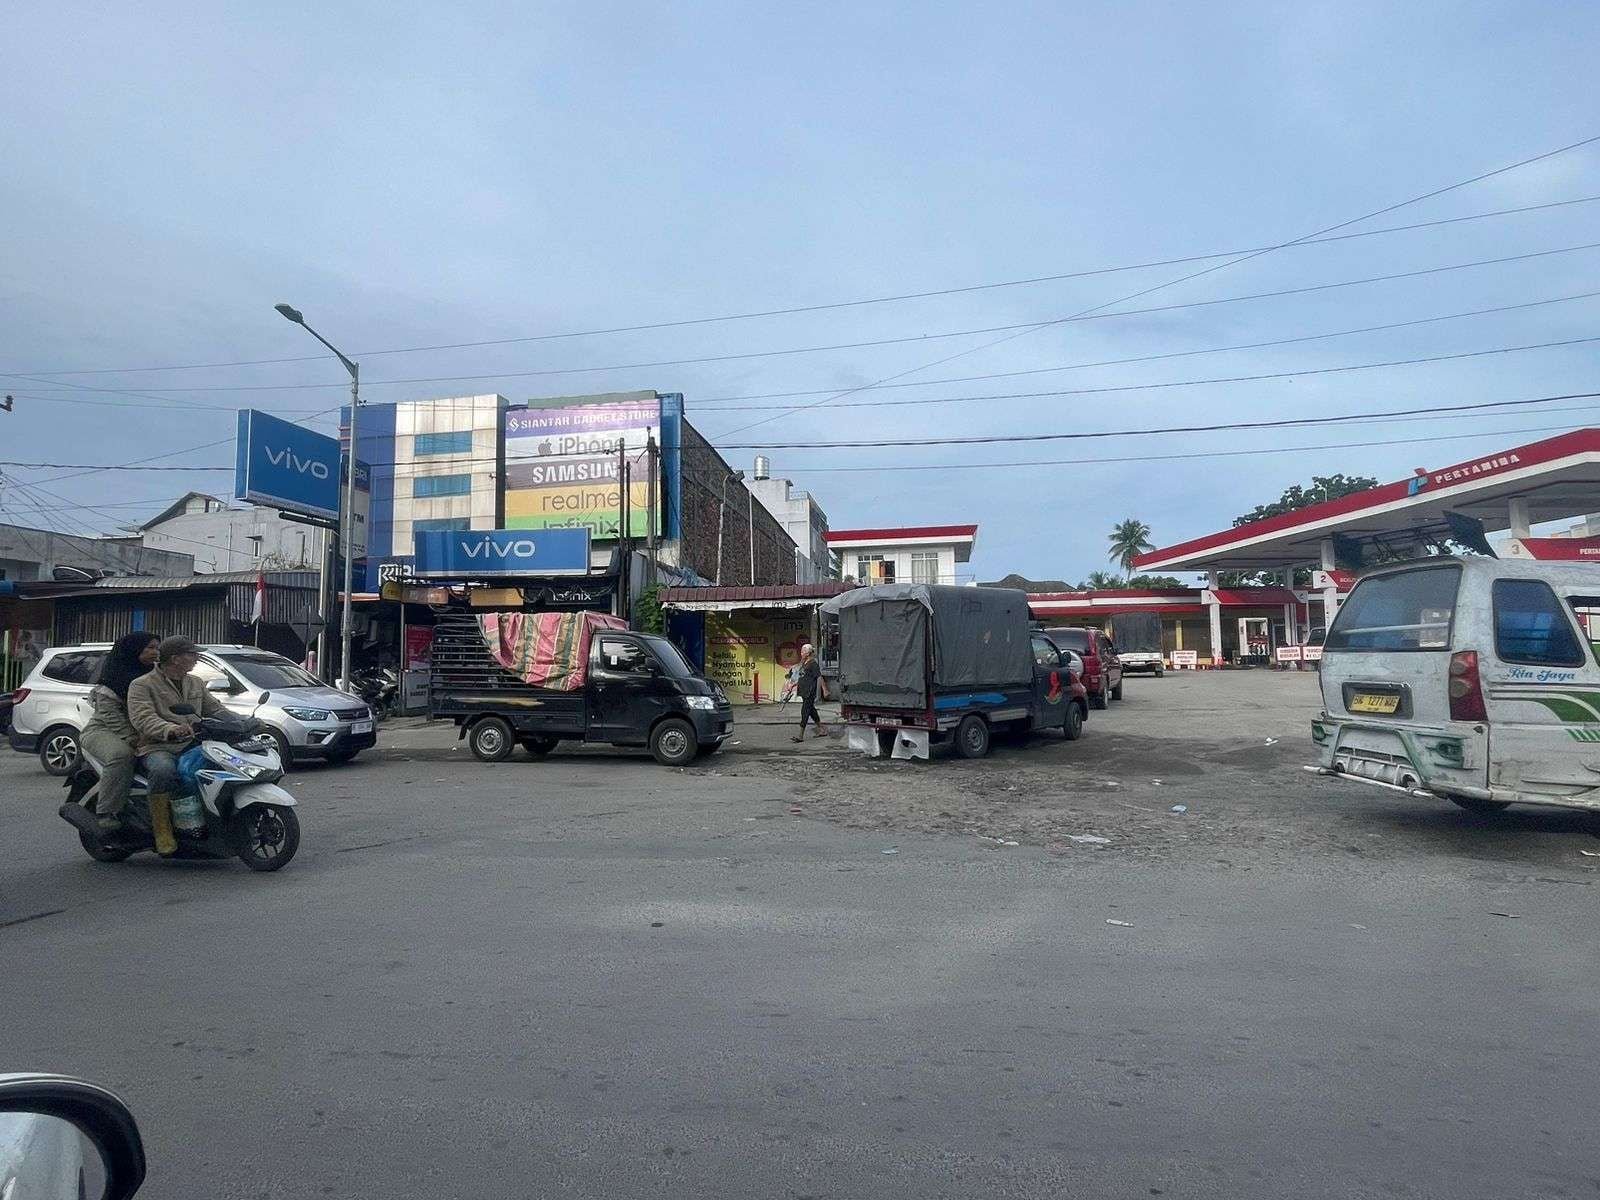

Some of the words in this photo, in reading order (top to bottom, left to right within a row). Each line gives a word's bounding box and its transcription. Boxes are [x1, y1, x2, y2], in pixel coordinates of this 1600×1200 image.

[521, 417, 570, 430] SIANTAR
[264, 445, 329, 480] vivo
[1435, 454, 1521, 484] PERTAMINA
[533, 461, 619, 483] SAMSUN
[542, 489, 620, 511] realme
[461, 535, 536, 558] vivo
[1511, 543, 1521, 555] 3
[1320, 574, 1327, 583] 2
[712, 651, 737, 660] Selalu
[712, 661, 756, 669] Nyambung
[712, 671, 742, 679] dengan
